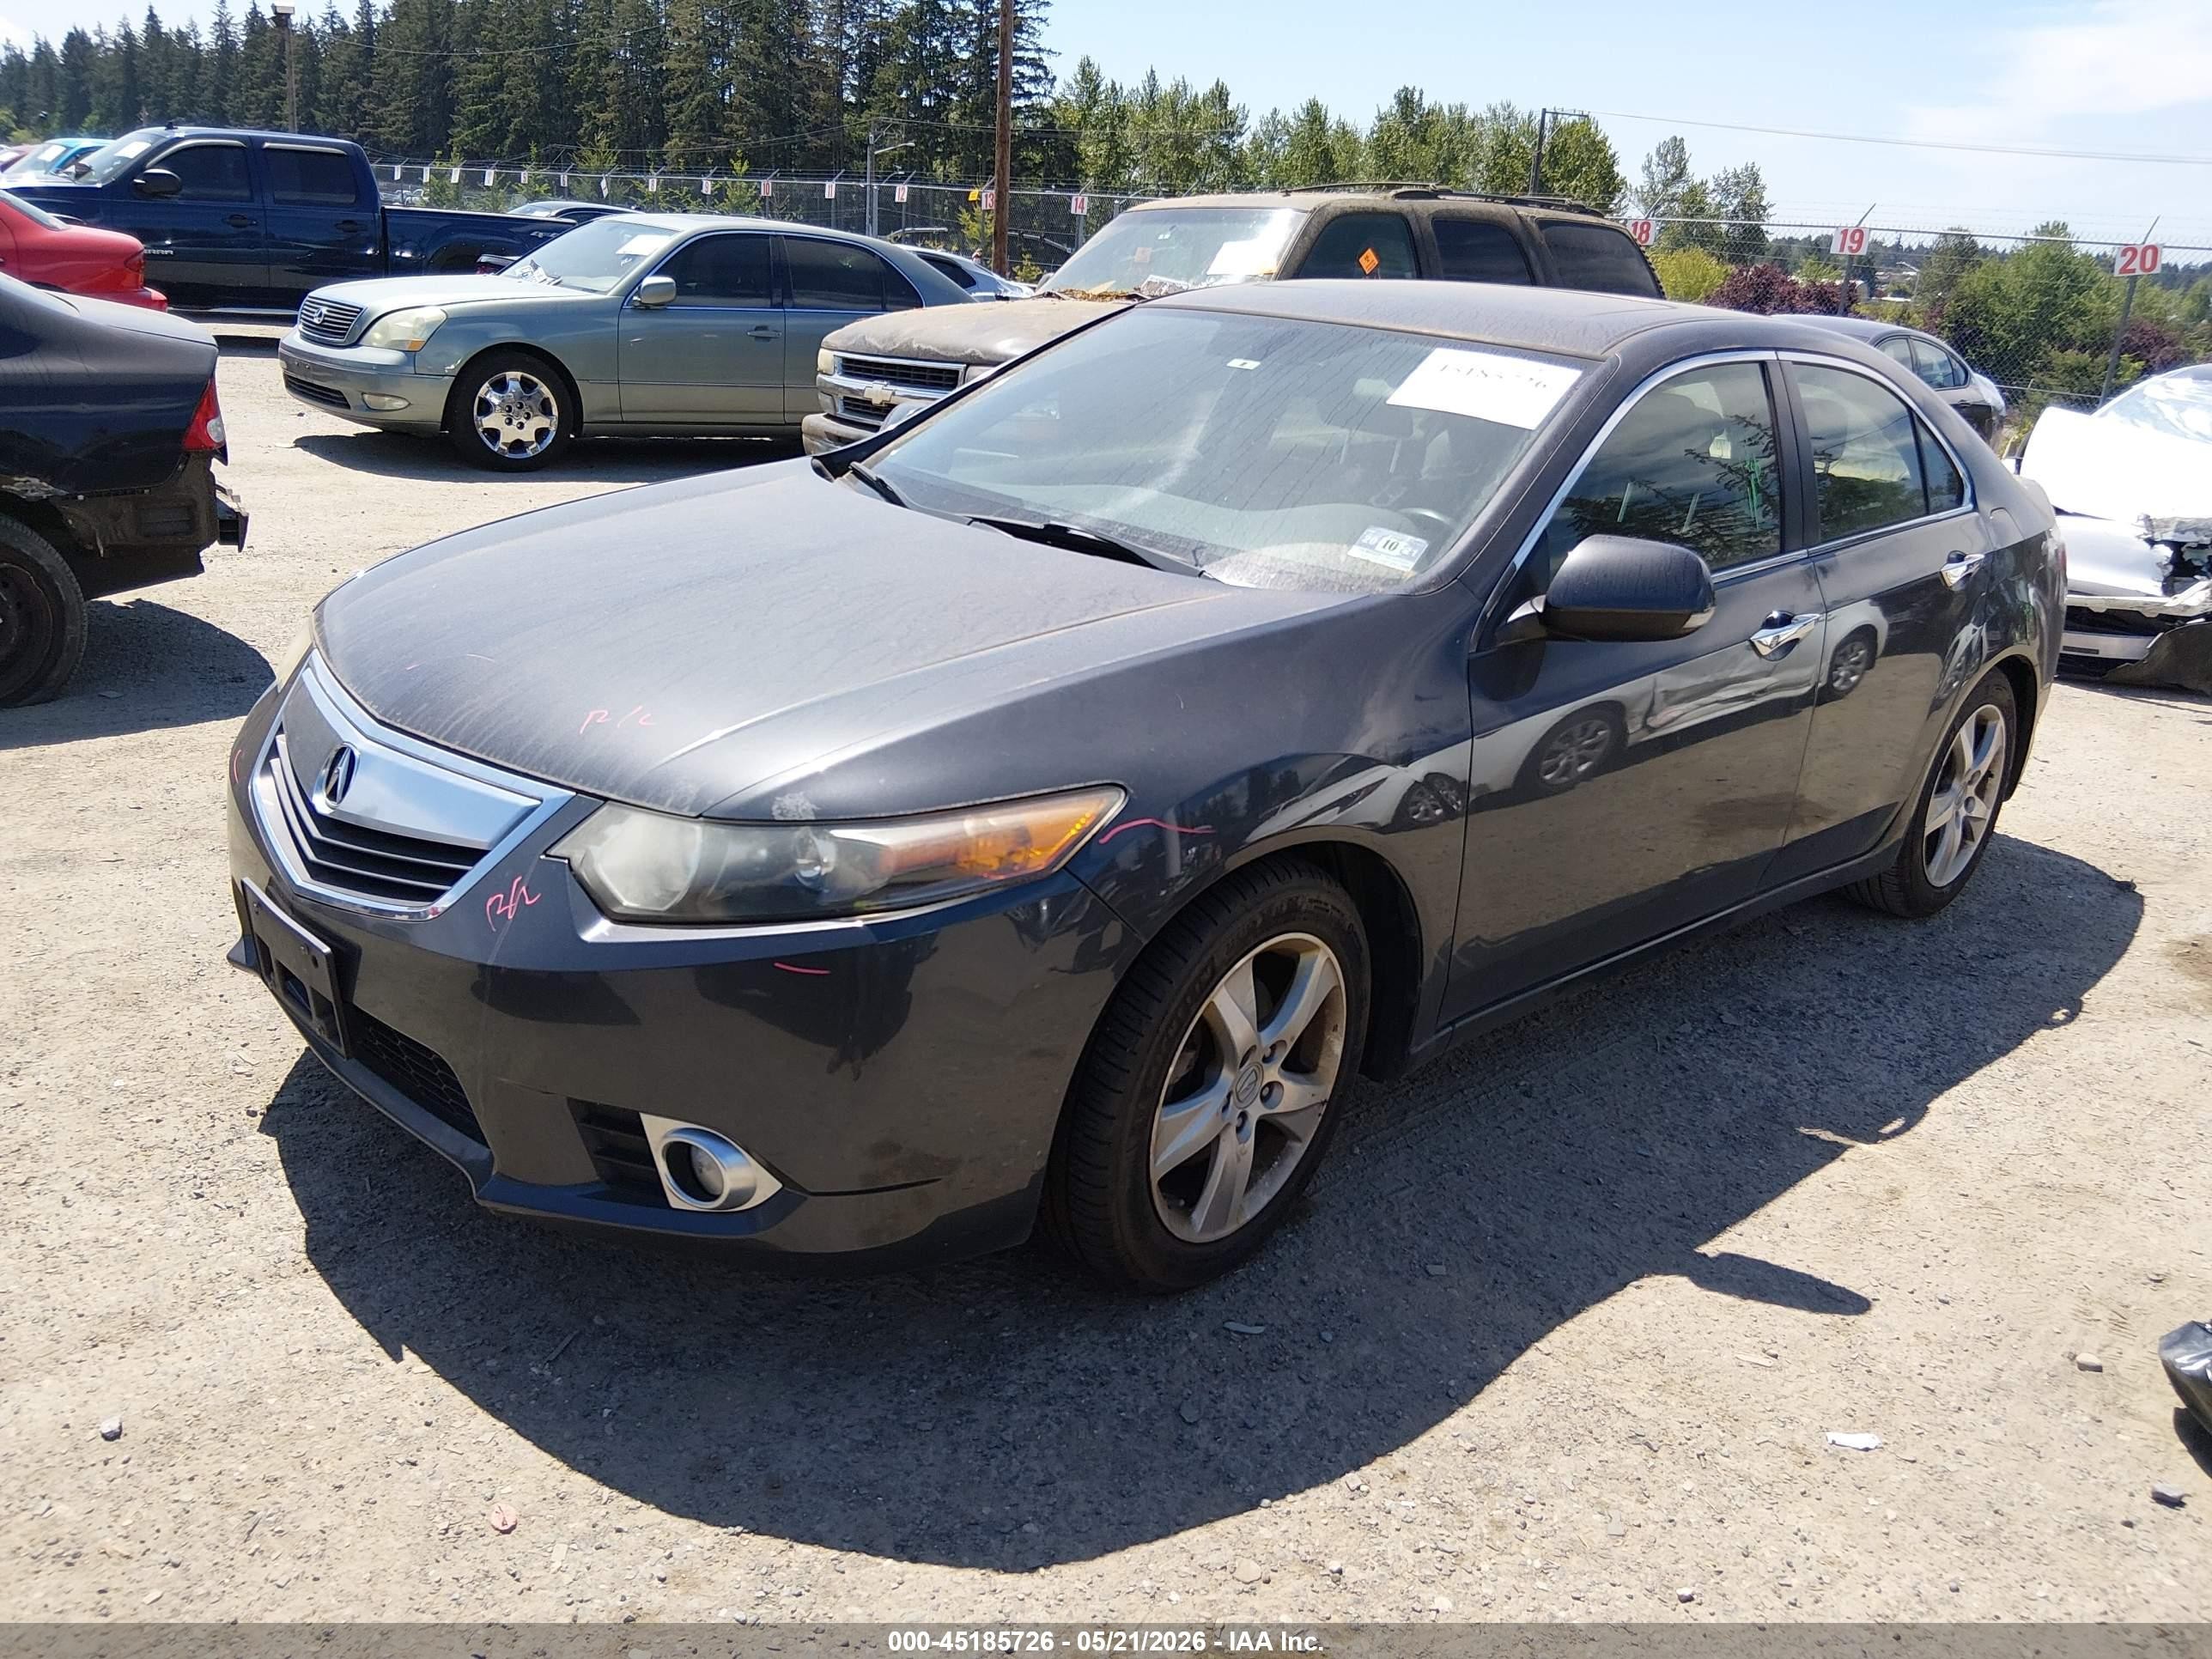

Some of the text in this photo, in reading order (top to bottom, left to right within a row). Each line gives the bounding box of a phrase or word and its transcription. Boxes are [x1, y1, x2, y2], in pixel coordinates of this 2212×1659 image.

[704, 180, 710, 193] 9
[763, 181, 770, 196] 10
[827, 184, 833, 198] 11
[897, 185, 906, 202] 12
[984, 192, 994, 209] 13
[1074, 197, 1085, 214] 14
[1632, 221, 1651, 244] 18
[1839, 228, 1864, 253] 19
[2118, 245, 2159, 275] 20
[1382, 539, 1400, 551] 10
